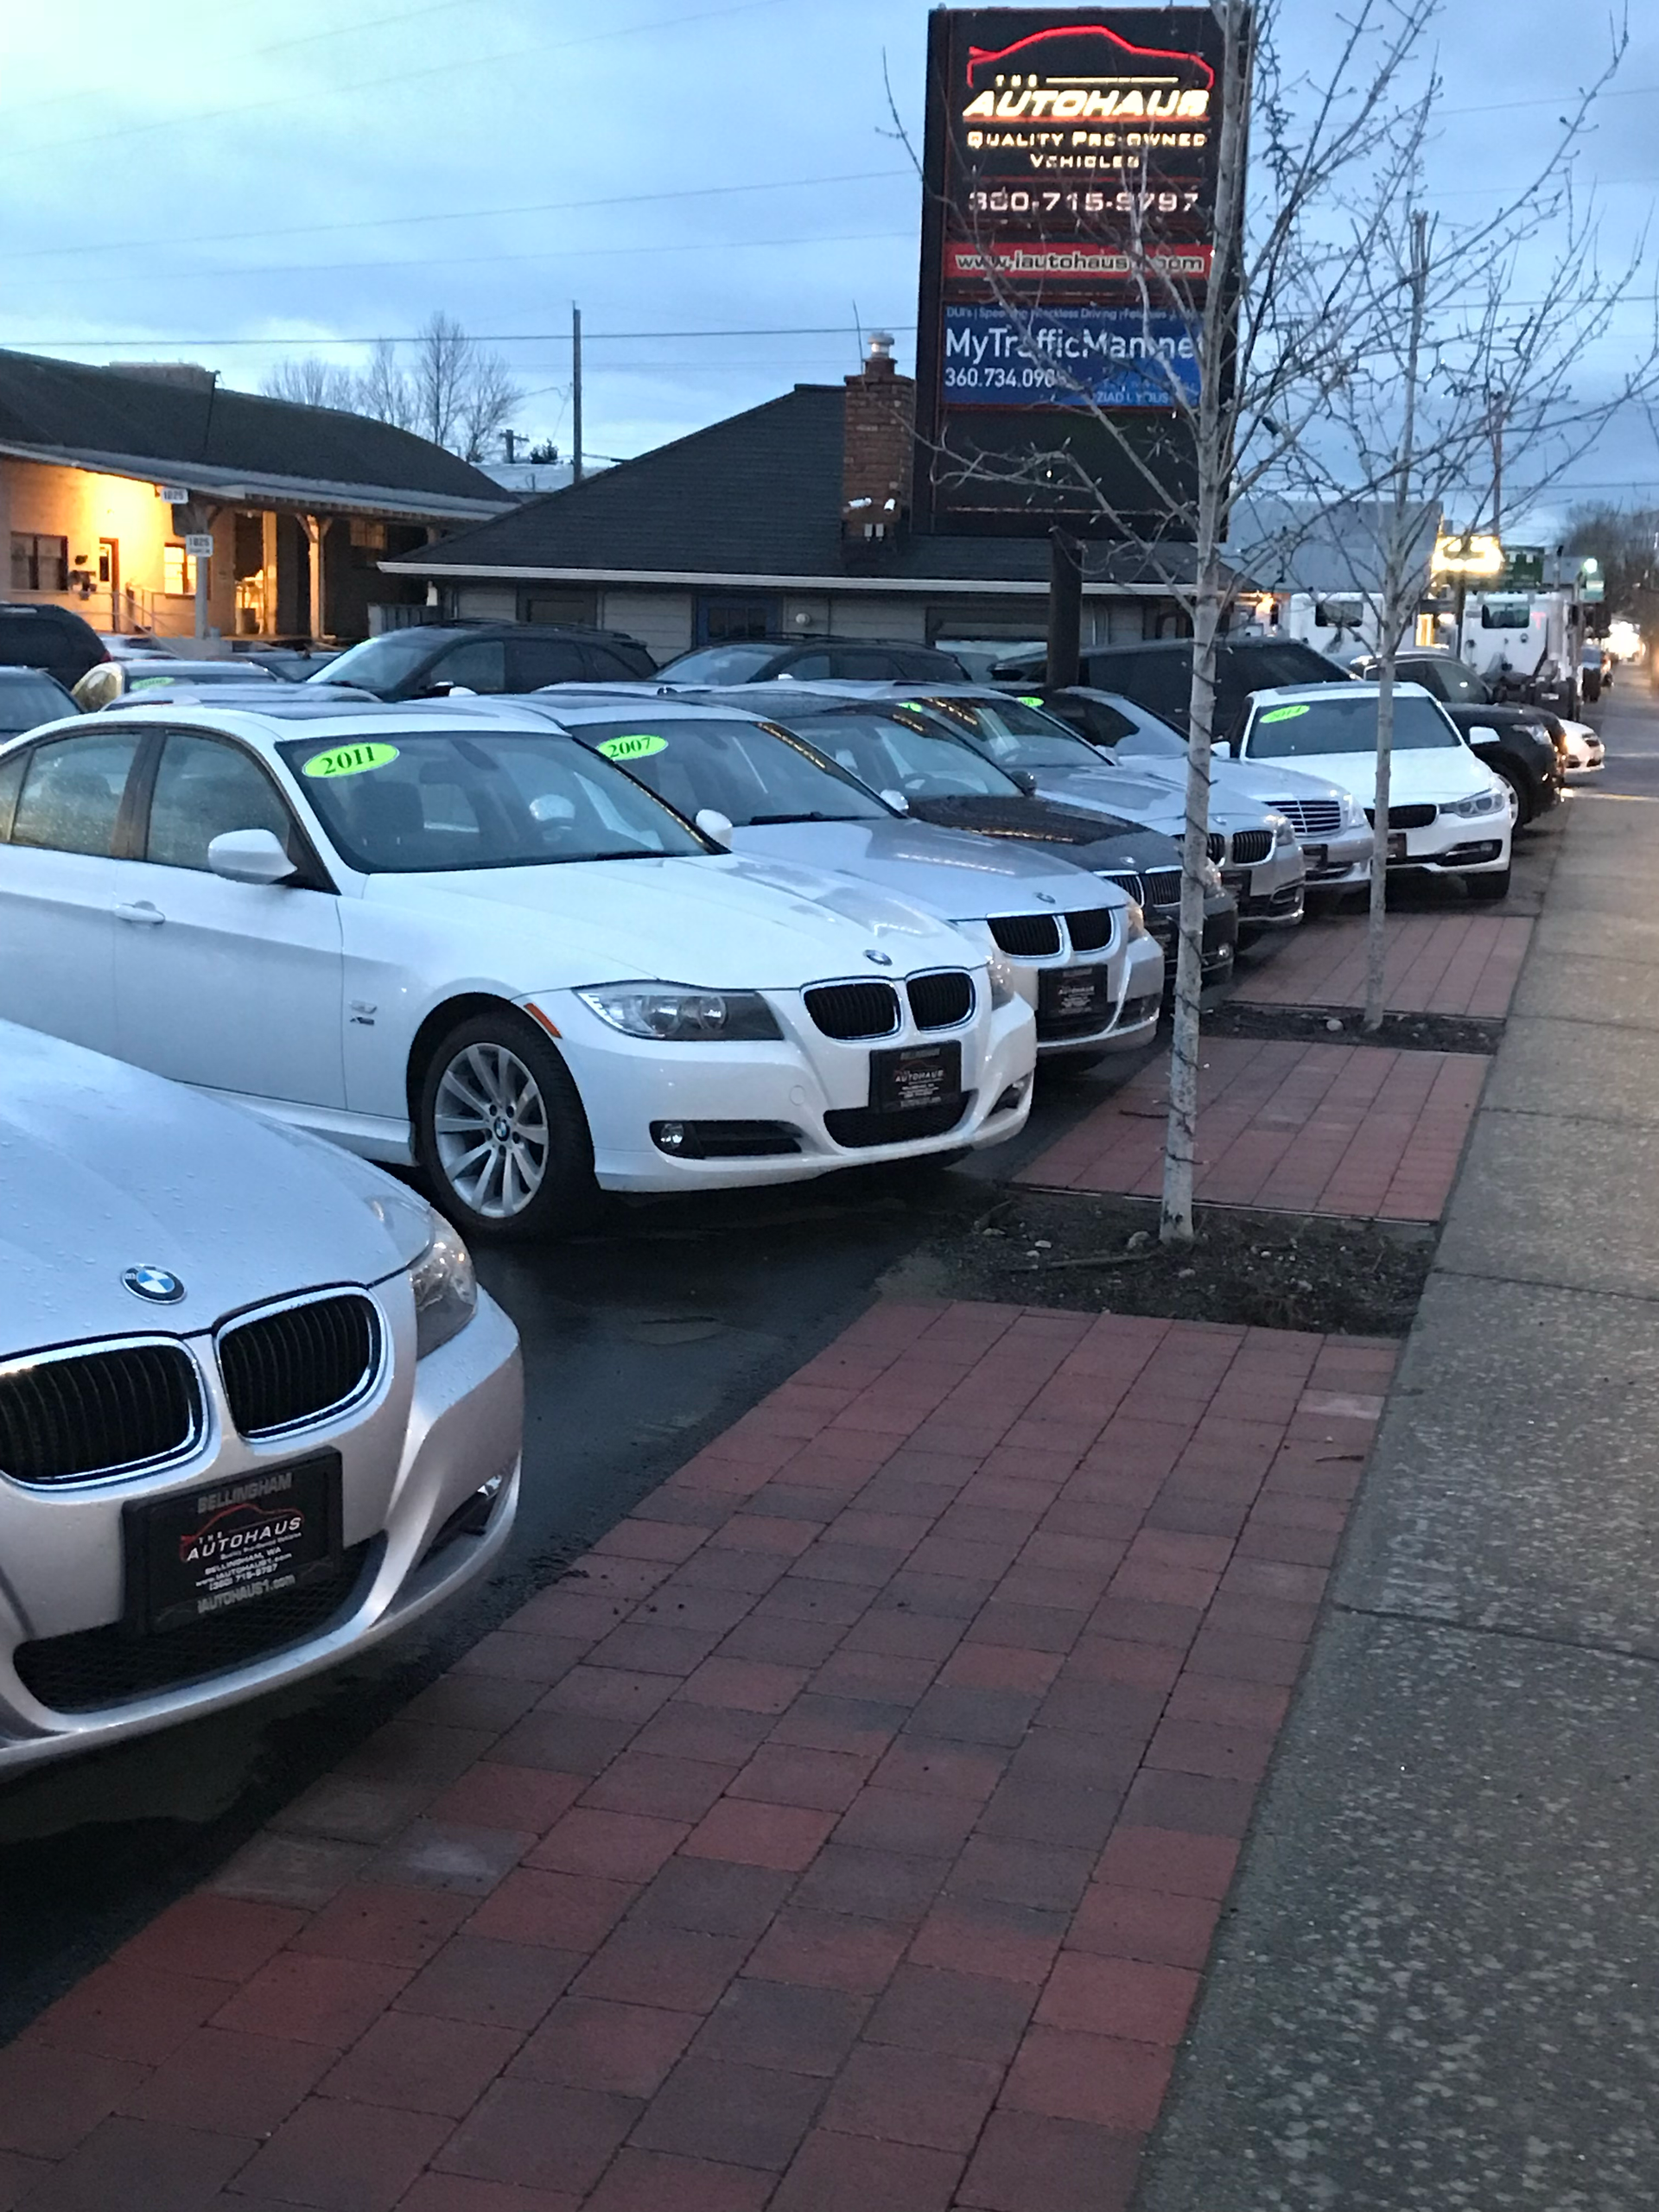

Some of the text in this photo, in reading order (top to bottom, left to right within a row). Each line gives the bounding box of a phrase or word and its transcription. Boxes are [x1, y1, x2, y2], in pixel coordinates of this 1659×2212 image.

[995, 74, 1038, 87] THE
[962, 89, 1211, 118] AUTOHAUS
[1029, 153, 1141, 169] VEHICLES
[1080, 308, 1117, 321] Driving
[1096, 391, 1125, 404] ZIAD
[608, 736, 651, 758] 2007
[320, 746, 375, 776] 2011
[197, 1471, 293, 1515] BELLINGHAM
[186, 1516, 302, 1562] AUTOHAUS
